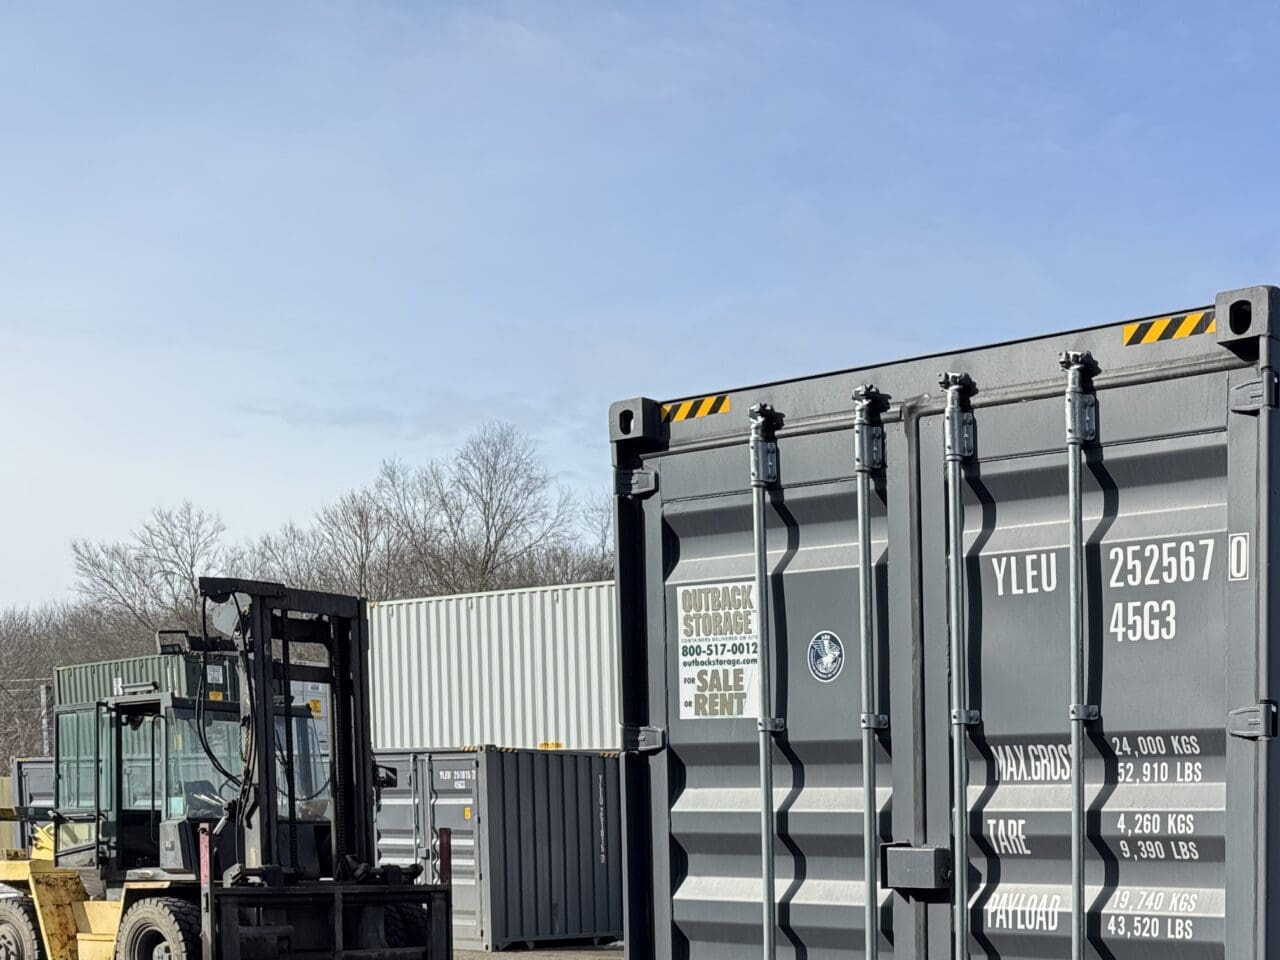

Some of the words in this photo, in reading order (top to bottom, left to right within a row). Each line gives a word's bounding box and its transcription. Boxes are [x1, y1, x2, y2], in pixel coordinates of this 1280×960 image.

[991, 552, 1057, 596] YLEU
[1109, 538, 1215, 588] 252567
[1230, 536, 1247, 578] 0
[682, 585, 754, 613] OUTBACK
[683, 610, 752, 637] STORAGE
[1109, 599, 1176, 642] 45G3
[681, 642, 758, 657] 800-517-0012
[682, 658, 758, 667] outbackstorage.com
[696, 668, 744, 692] SALE
[684, 700, 693, 708] OR
[694, 692, 747, 716] RENT
[1112, 736, 1166, 758] 24,000
[1171, 735, 1200, 755] KGS
[1117, 762, 1169, 786] 52,910
[1176, 762, 1202, 782] LBS
[987, 819, 1032, 855] TARE
[1117, 813, 1160, 837] 4,260
[1168, 813, 1194, 834] KGS
[1120, 840, 1165, 861] 9,390
[1170, 841, 1199, 860] LBS
[987, 893, 1061, 931] PAYLOAD
[1113, 890, 1164, 912] 19,740
[1169, 892, 1198, 912] KGS
[1107, 915, 1159, 939] 43,520
[1167, 918, 1193, 940] LBS
